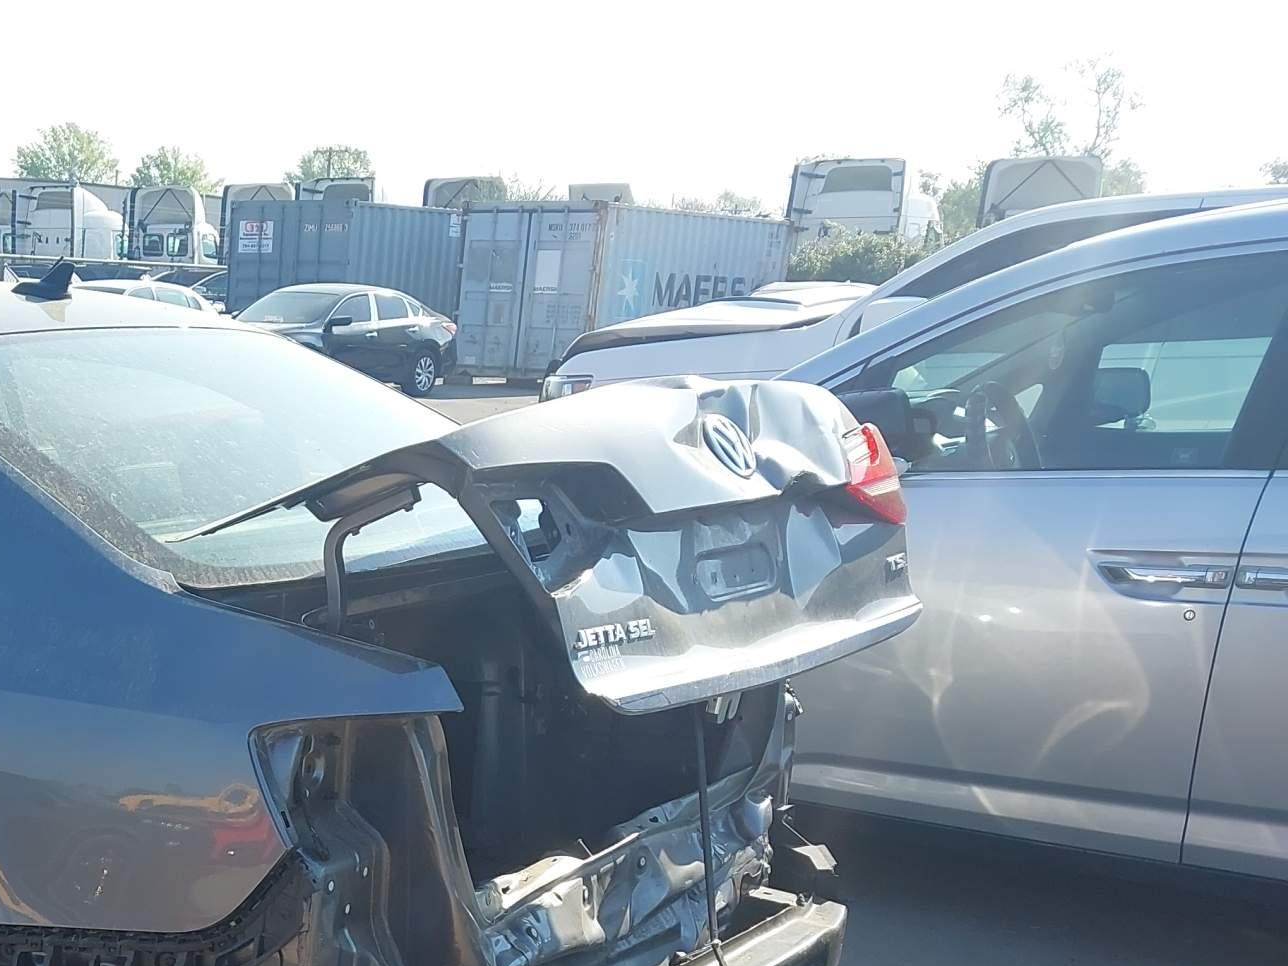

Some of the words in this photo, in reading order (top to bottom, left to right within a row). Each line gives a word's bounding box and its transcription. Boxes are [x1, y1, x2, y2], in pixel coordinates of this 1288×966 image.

[652, 271, 758, 307] MAERS
[575, 623, 626, 650] JETTA
[627, 618, 656, 639] SEL
